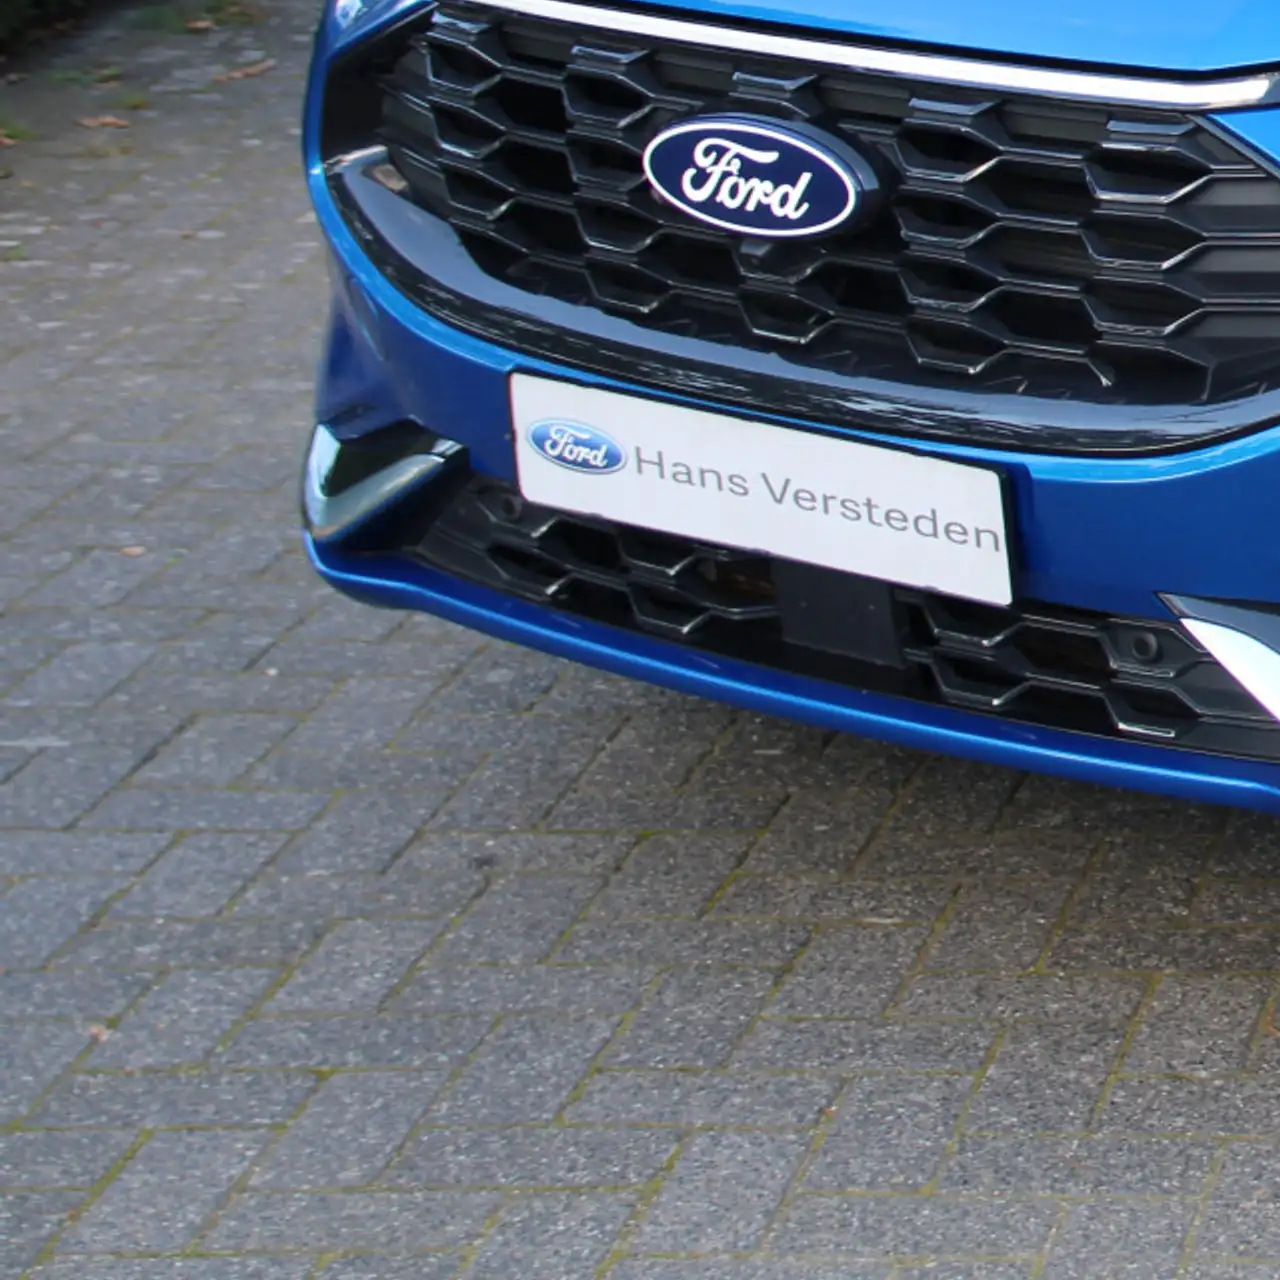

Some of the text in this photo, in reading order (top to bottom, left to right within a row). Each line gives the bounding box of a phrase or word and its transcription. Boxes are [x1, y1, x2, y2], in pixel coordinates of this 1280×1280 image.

[681, 137, 813, 220] Ford
[543, 424, 1001, 553] Ford Hans Versteden
